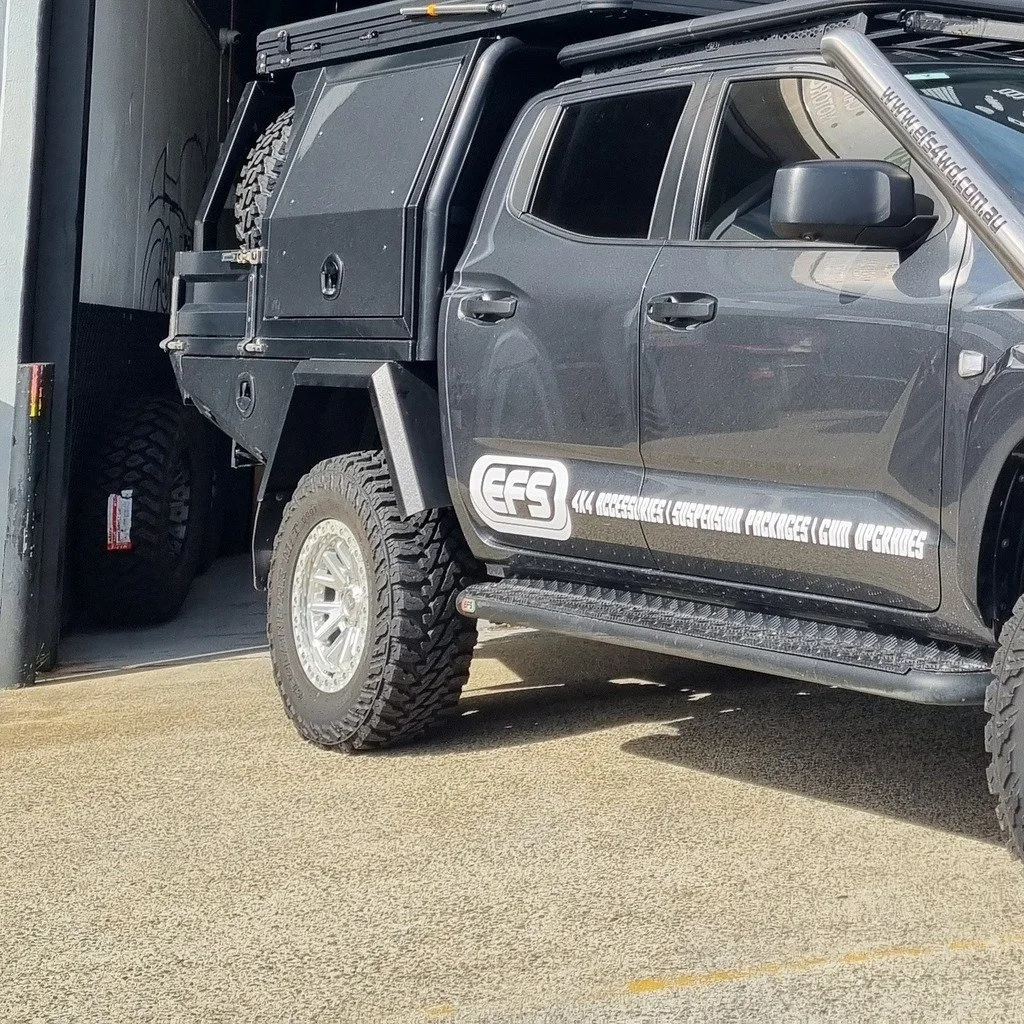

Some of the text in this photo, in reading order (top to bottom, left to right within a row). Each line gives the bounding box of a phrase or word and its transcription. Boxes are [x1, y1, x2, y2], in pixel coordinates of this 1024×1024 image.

[880, 86, 1007, 234] www.efs4wd.com.au
[482, 466, 554, 519] EFS
[595, 492, 666, 524] ACCESSORIES
[671, 500, 742, 534] SUSPENSION
[745, 508, 809, 543] PACKAGES
[854, 522, 928, 559] UPGRADES
